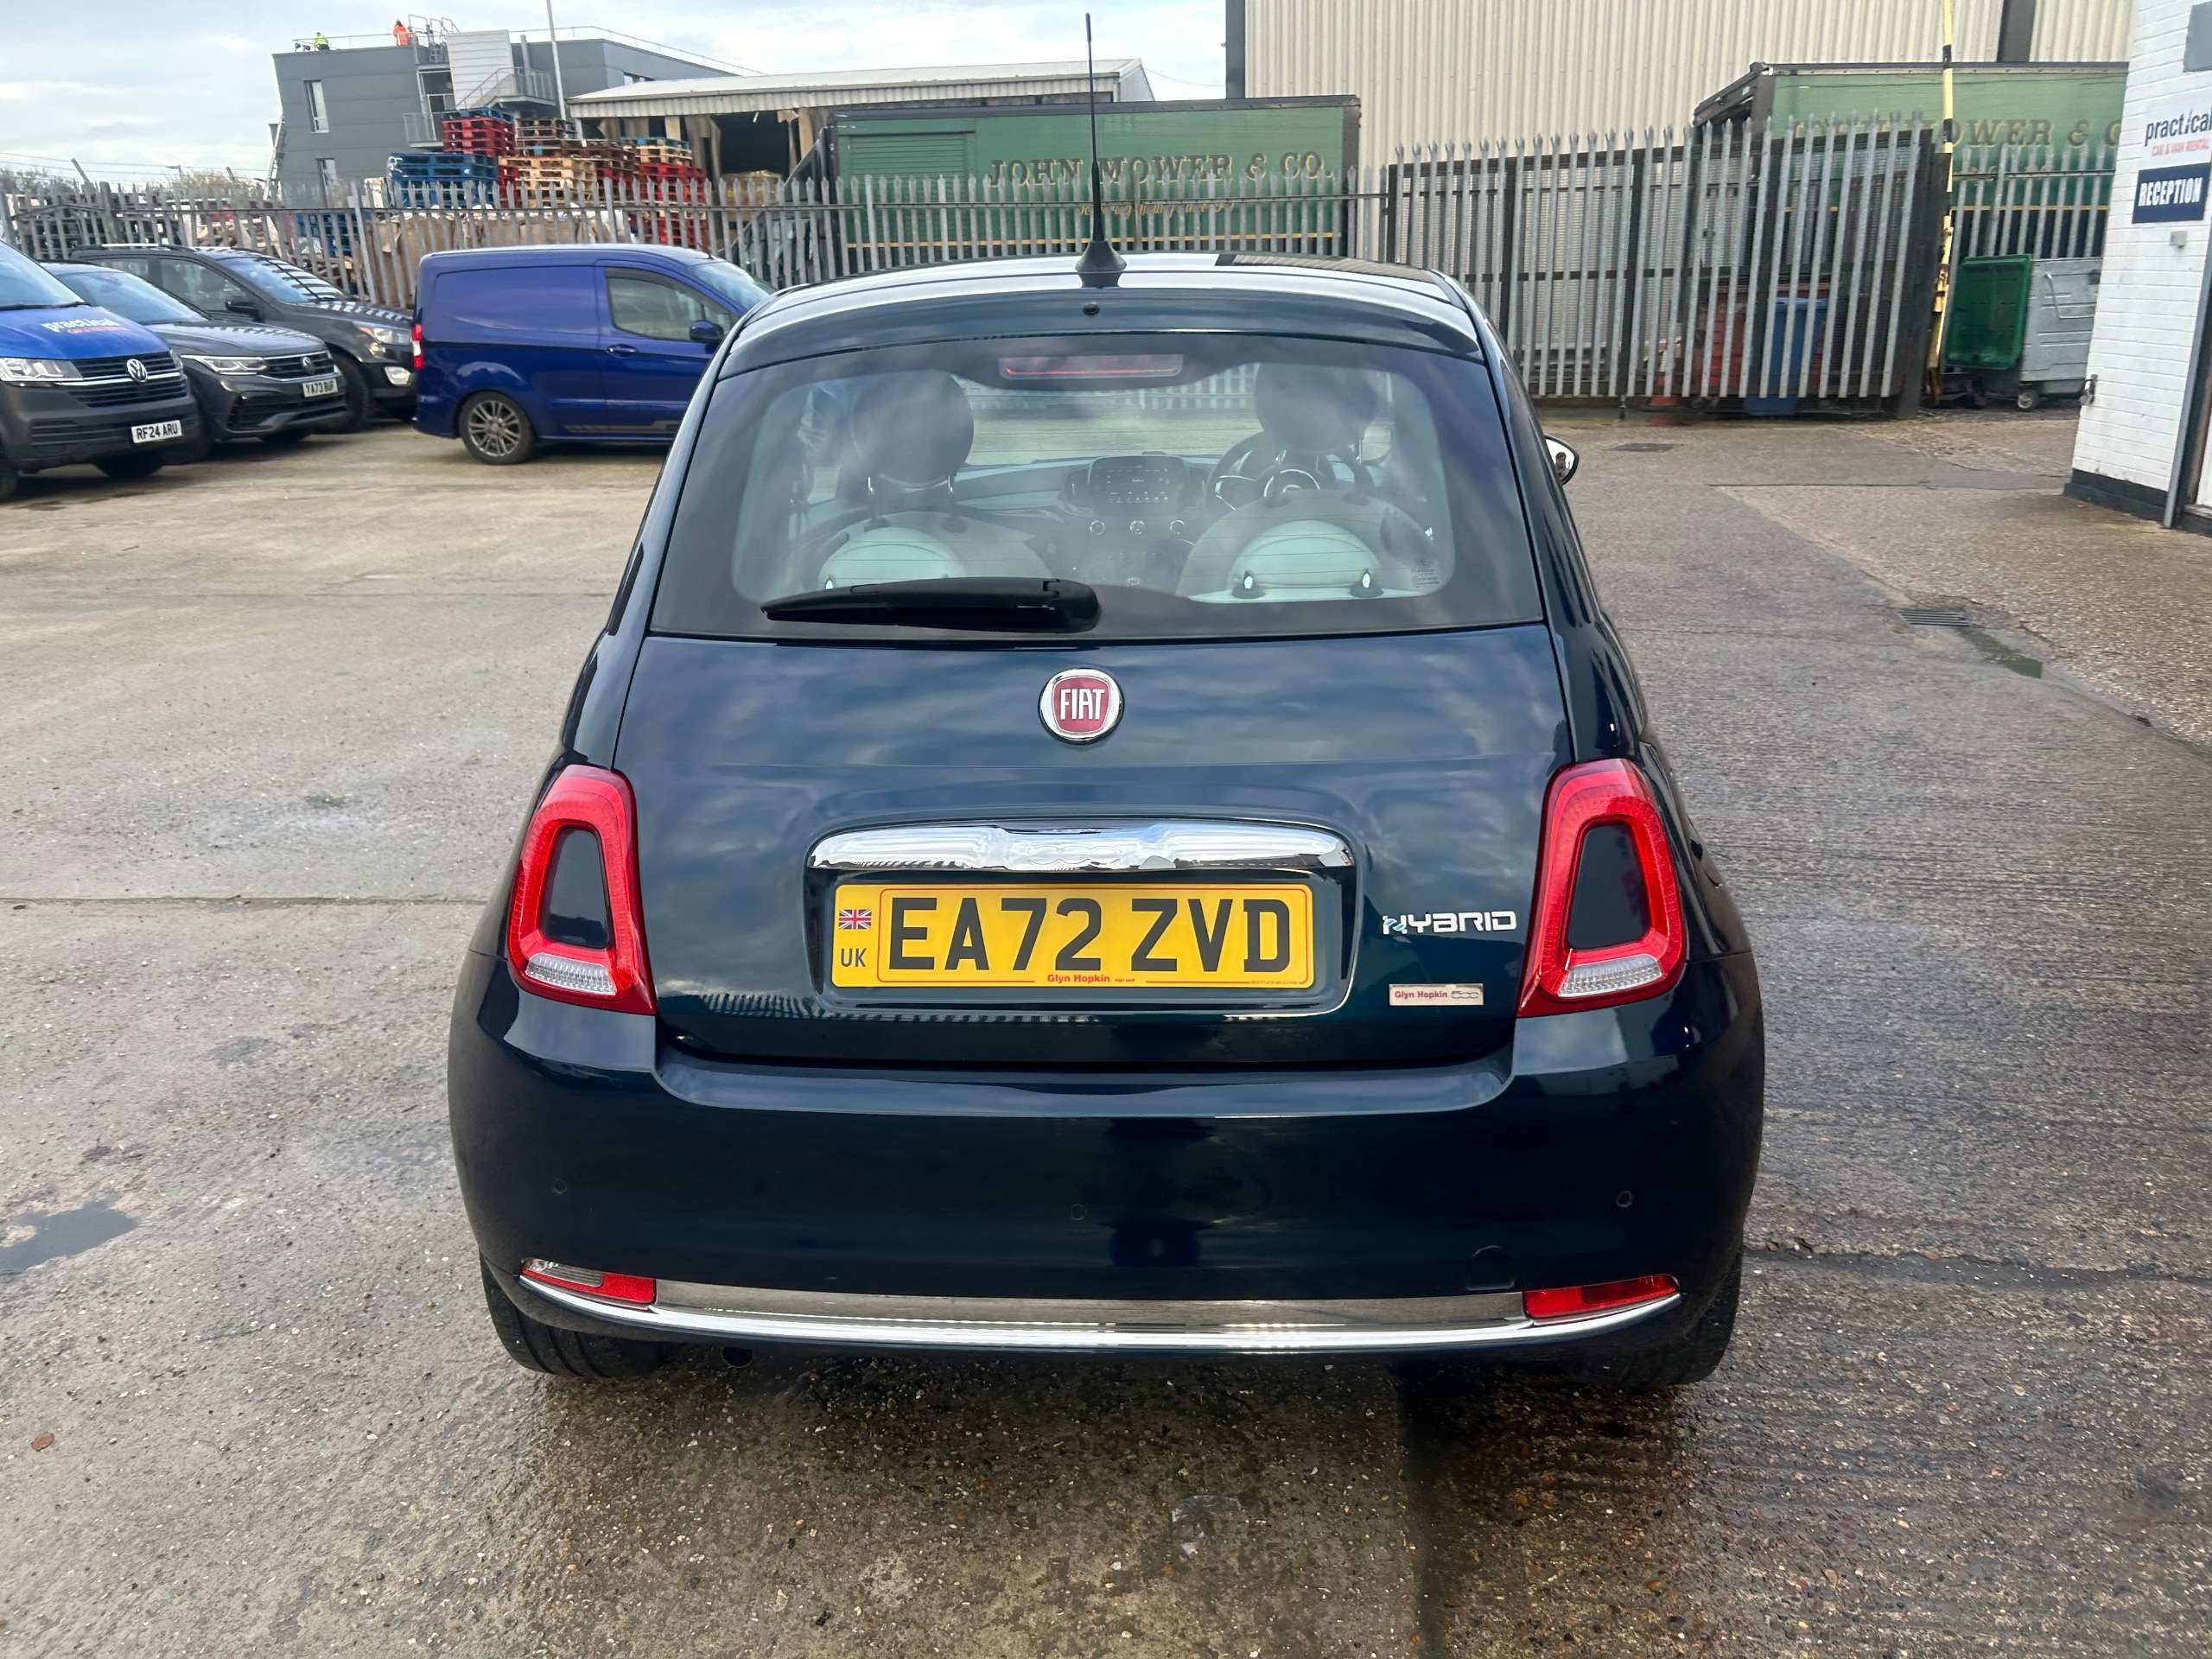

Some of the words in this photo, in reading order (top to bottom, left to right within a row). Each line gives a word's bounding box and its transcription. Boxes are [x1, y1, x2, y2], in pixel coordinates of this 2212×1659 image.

[990, 159, 1084, 187] JOHN
[1097, 154, 1234, 185] MOWER
[1244, 153, 1268, 181] &
[2138, 177, 2203, 207] RECEPTION
[136, 426, 161, 440] RF24
[162, 423, 178, 436] ARU
[1060, 689, 1105, 720] FIAT
[889, 897, 1102, 971] EA72
[1130, 898, 1290, 973] ZVD
[1382, 911, 1517, 935] HYBRID
[840, 948, 867, 968] UK
[1047, 974, 1071, 984] Glyn
[1073, 974, 1110, 984] Hopkin
[1395, 990, 1414, 1000] Glyn
[1417, 990, 1448, 1000] Hopkin
